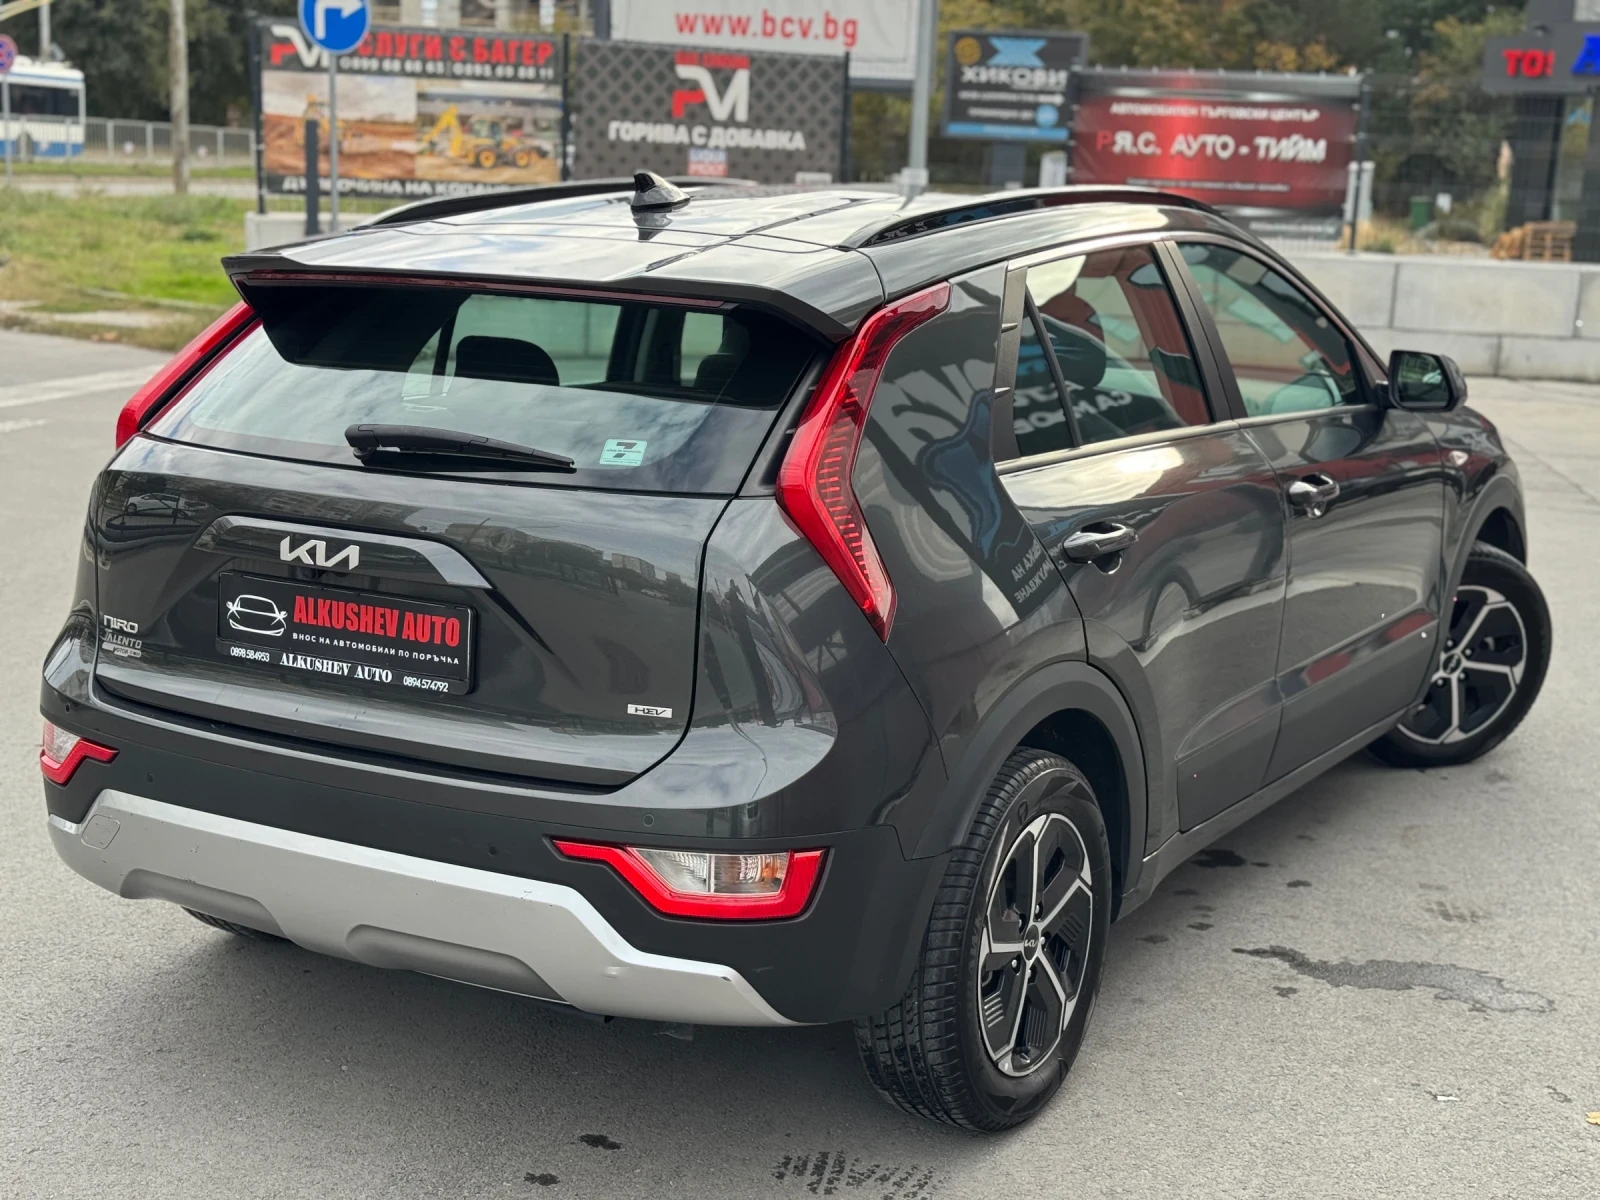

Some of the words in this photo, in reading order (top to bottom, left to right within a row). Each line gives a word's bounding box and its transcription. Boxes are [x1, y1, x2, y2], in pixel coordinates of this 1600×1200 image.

[675, 10, 858, 47] www.bcv.bg
[473, 37, 554, 66] БАГЕР
[608, 120, 690, 145] ГОРИВА
[692, 125, 708, 146] С
[708, 126, 807, 151] ДОБАВКА
[1170, 133, 1237, 160] АУТО
[280, 536, 360, 570] KIA
[104, 614, 138, 634] NIRO
[293, 595, 399, 637] ALKUSHEV
[401, 611, 460, 647] AUTO
[292, 632, 317, 643] ВНОС
[319, 636, 330, 645] НА
[333, 639, 396, 656] АВТОМОБИЛИ
[398, 649, 409, 658] ПО
[412, 652, 459, 665] ПОРЪЧКА
[280, 653, 351, 676] ALKUSHEV
[354, 665, 392, 683] AUTO
[635, 706, 667, 716] HEV
